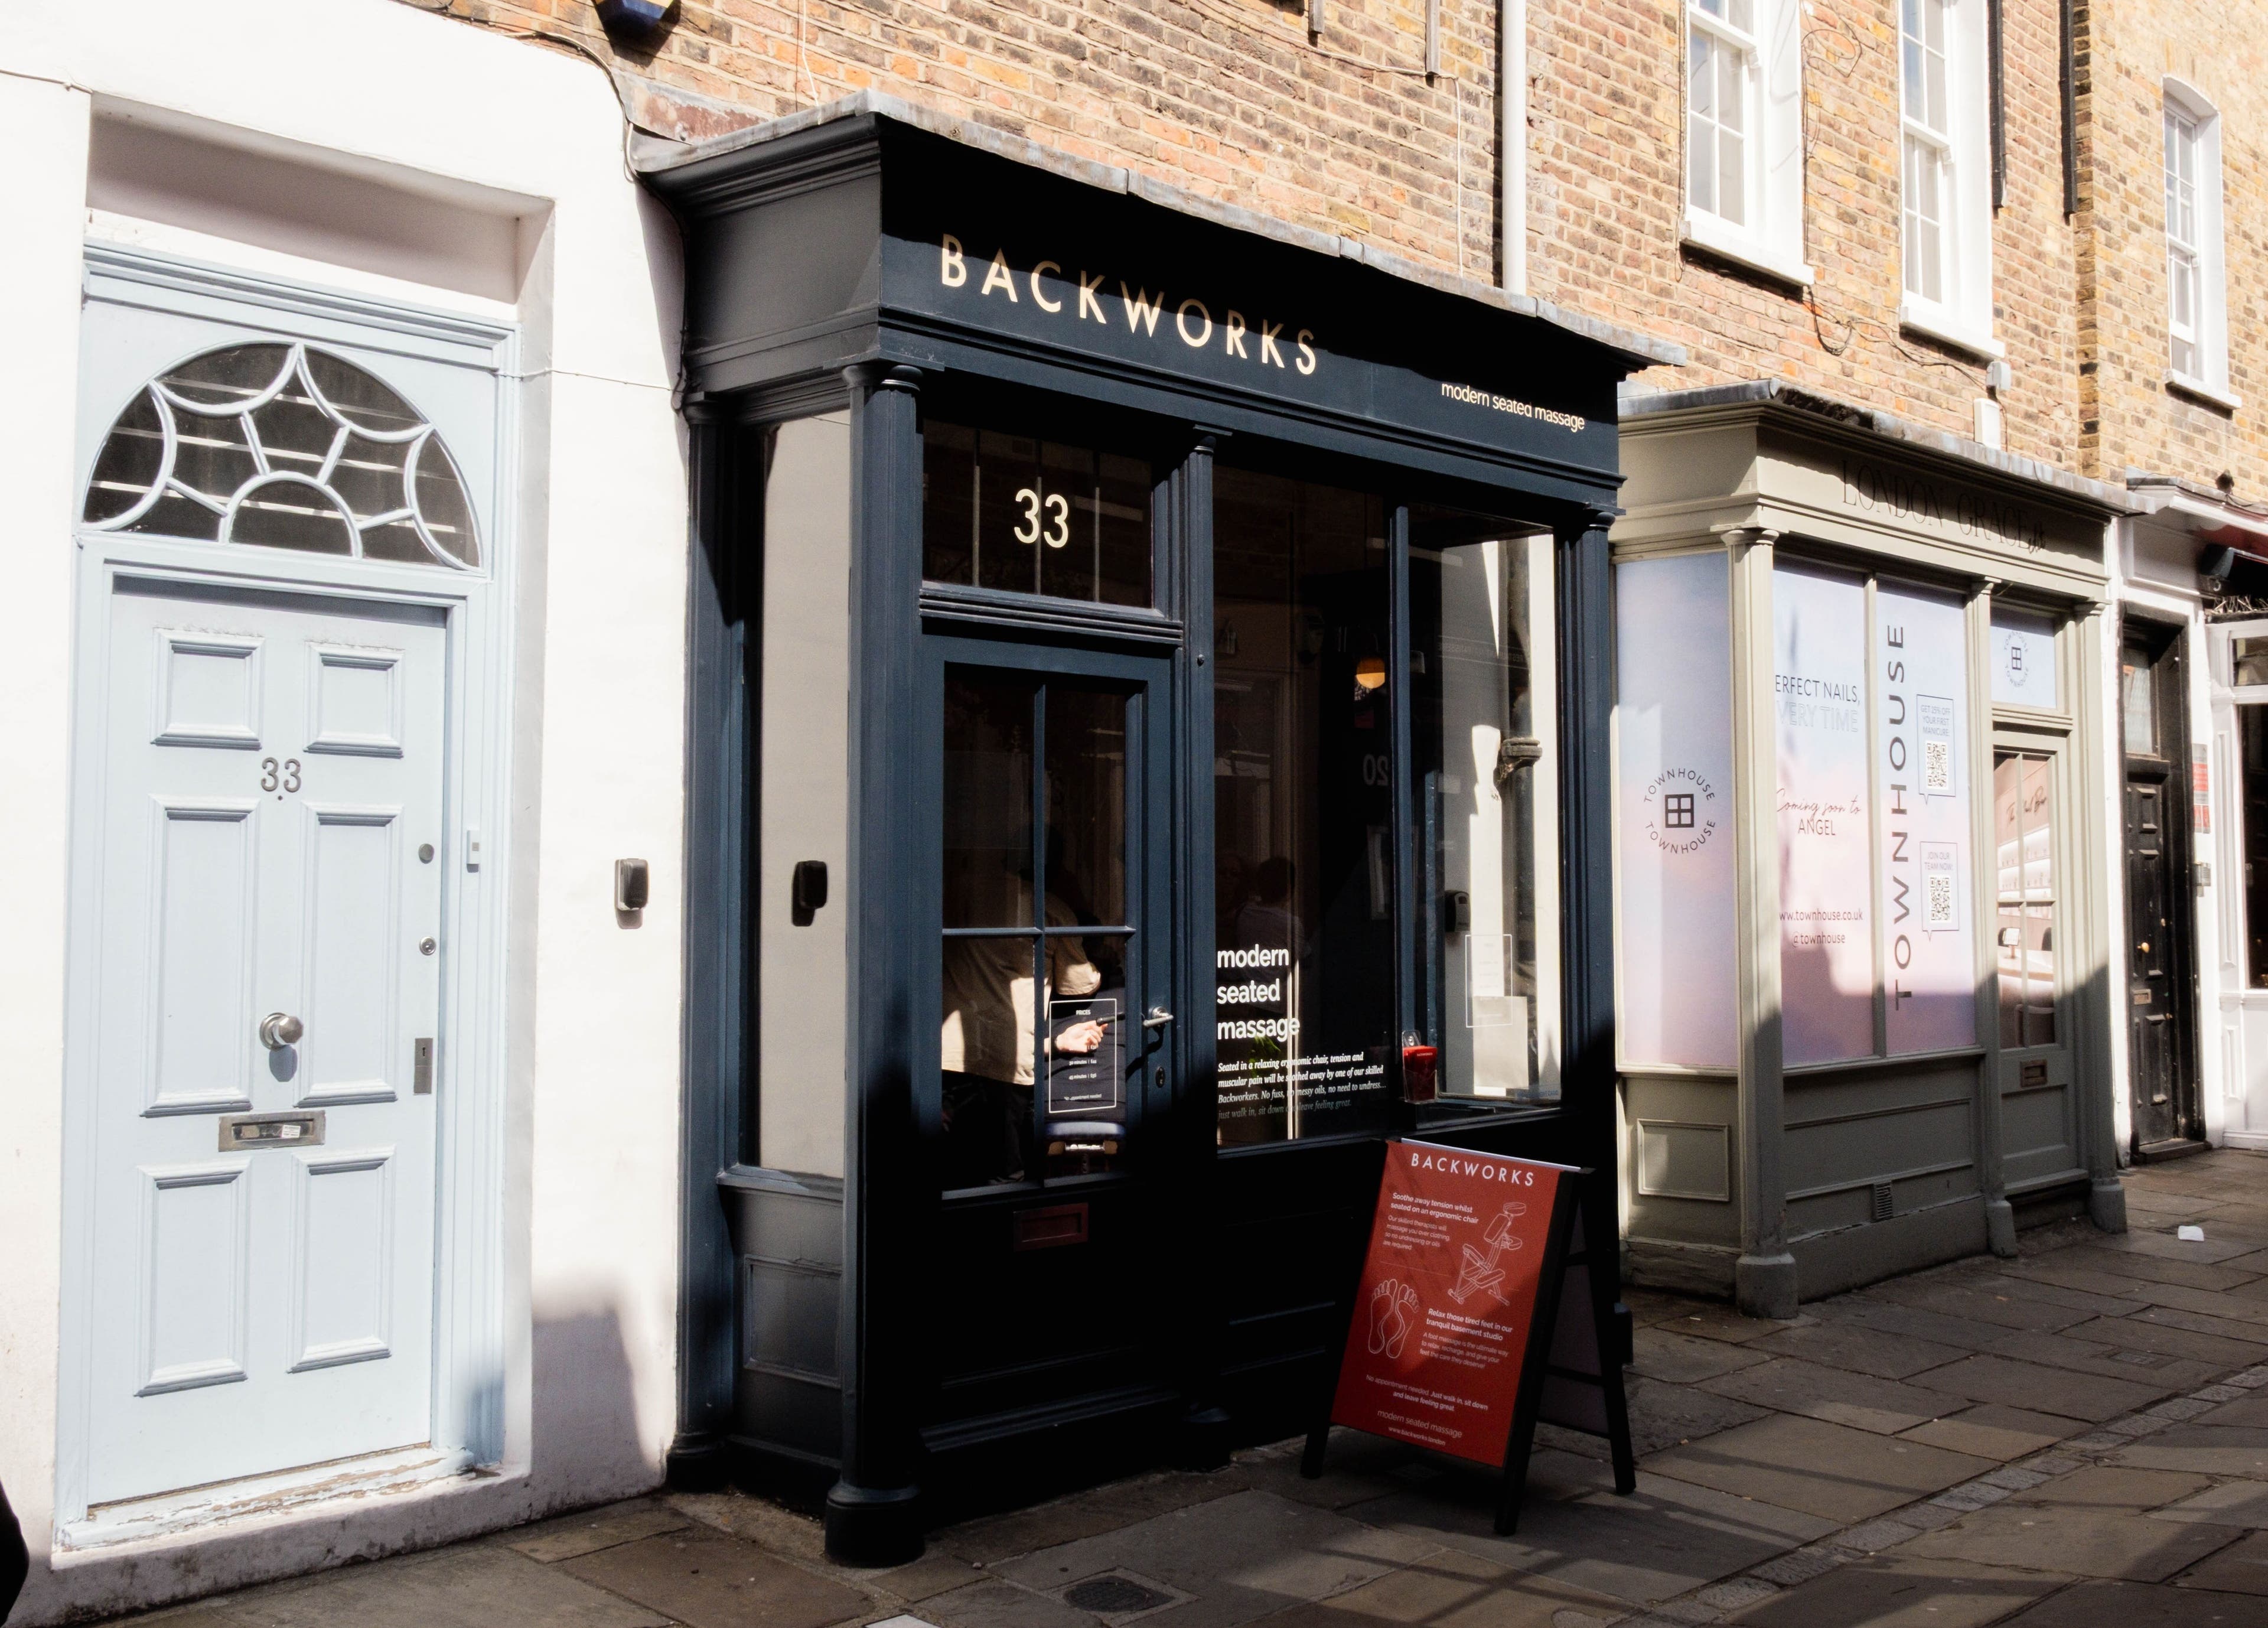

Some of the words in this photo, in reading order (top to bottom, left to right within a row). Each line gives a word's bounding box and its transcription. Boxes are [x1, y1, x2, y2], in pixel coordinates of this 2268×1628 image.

[942, 233, 1316, 375] BACKWORKS
[1442, 383, 1490, 407] modern
[1493, 396, 1532, 418] seated
[1535, 407, 1585, 432] massage
[1842, 460, 1943, 527] LONDON
[1957, 493, 2029, 549] GRACE
[1014, 488, 1069, 548] 33
[1775, 674, 1820, 698] ERFECT
[1823, 681, 1860, 706] NAILS,
[1776, 699, 1817, 727] VERY
[1819, 705, 1859, 732] TIME
[260, 757, 301, 793] 33
[1644, 767, 1715, 803] TOWNHOUSE
[1821, 802, 1846, 816] soon
[1850, 795, 1862, 815] to
[1887, 624, 1912, 1011] TOWNHOUSE
[1645, 819, 1716, 854] TOWNHOUSE
[1797, 818, 1836, 836] ANGEL
[1793, 930, 1846, 948] @townhouse
[1217, 944, 1289, 968] modern
[1217, 978, 1280, 1004] seated
[1217, 1017, 1300, 1042] massage
[1218, 1061, 1240, 1072] Seated
[1240, 1061, 1247, 1070] in
[1254, 1059, 1280, 1070] relaxing
[1312, 1054, 1329, 1065] chair,
[1330, 1053, 1351, 1063] tension
[1352, 1051, 1364, 1062] and
[1218, 1076, 1248, 1087] muscular
[1248, 1075, 1263, 1087] pain
[1264, 1073, 1276, 1084] will
[1277, 1073, 1285, 1083] be
[1309, 1072, 1326, 1081] away
[1327, 1069, 1334, 1080] by
[1347, 1067, 1354, 1079] of
[1365, 1064, 1384, 1075] skilled
[1218, 1092, 1260, 1104] Backworkers.
[1261, 1090, 1270, 1099] No
[1270, 1089, 1285, 1101] fuss,
[1314, 1085, 1327, 1095] oils,
[1337, 1082, 1351, 1092] need
[1231, 1107, 1247, 1118] walk
[1267, 1105, 1284, 1114] down
[1285, 1103, 1297, 1113] ad
[1314, 1099, 1335, 1112] feeling
[1411, 1152, 1534, 1187] BACKWORKS
[1390, 1202, 1411, 1212] seated
[1429, 1210, 1462, 1222] ergonomic
[1462, 1215, 1479, 1224] chair
[1392, 1192, 1414, 1203] Soothe
[1414, 1197, 1430, 1207] away
[1431, 1199, 1454, 1210] tension
[1454, 1204, 1473, 1213] whilst
[1426, 1318, 1451, 1330] tranquil
[1451, 1323, 1482, 1337] basement
[1483, 1331, 1503, 1342] studio
[1428, 1308, 1446, 1318] Relax
[1446, 1311, 1464, 1323] those
[1465, 1316, 1480, 1326] tired
[1480, 1319, 1494, 1329] feet
[1377, 1409, 1405, 1423] modern
[1405, 1415, 1430, 1430] seated
[1430, 1424, 1463, 1439] massage
